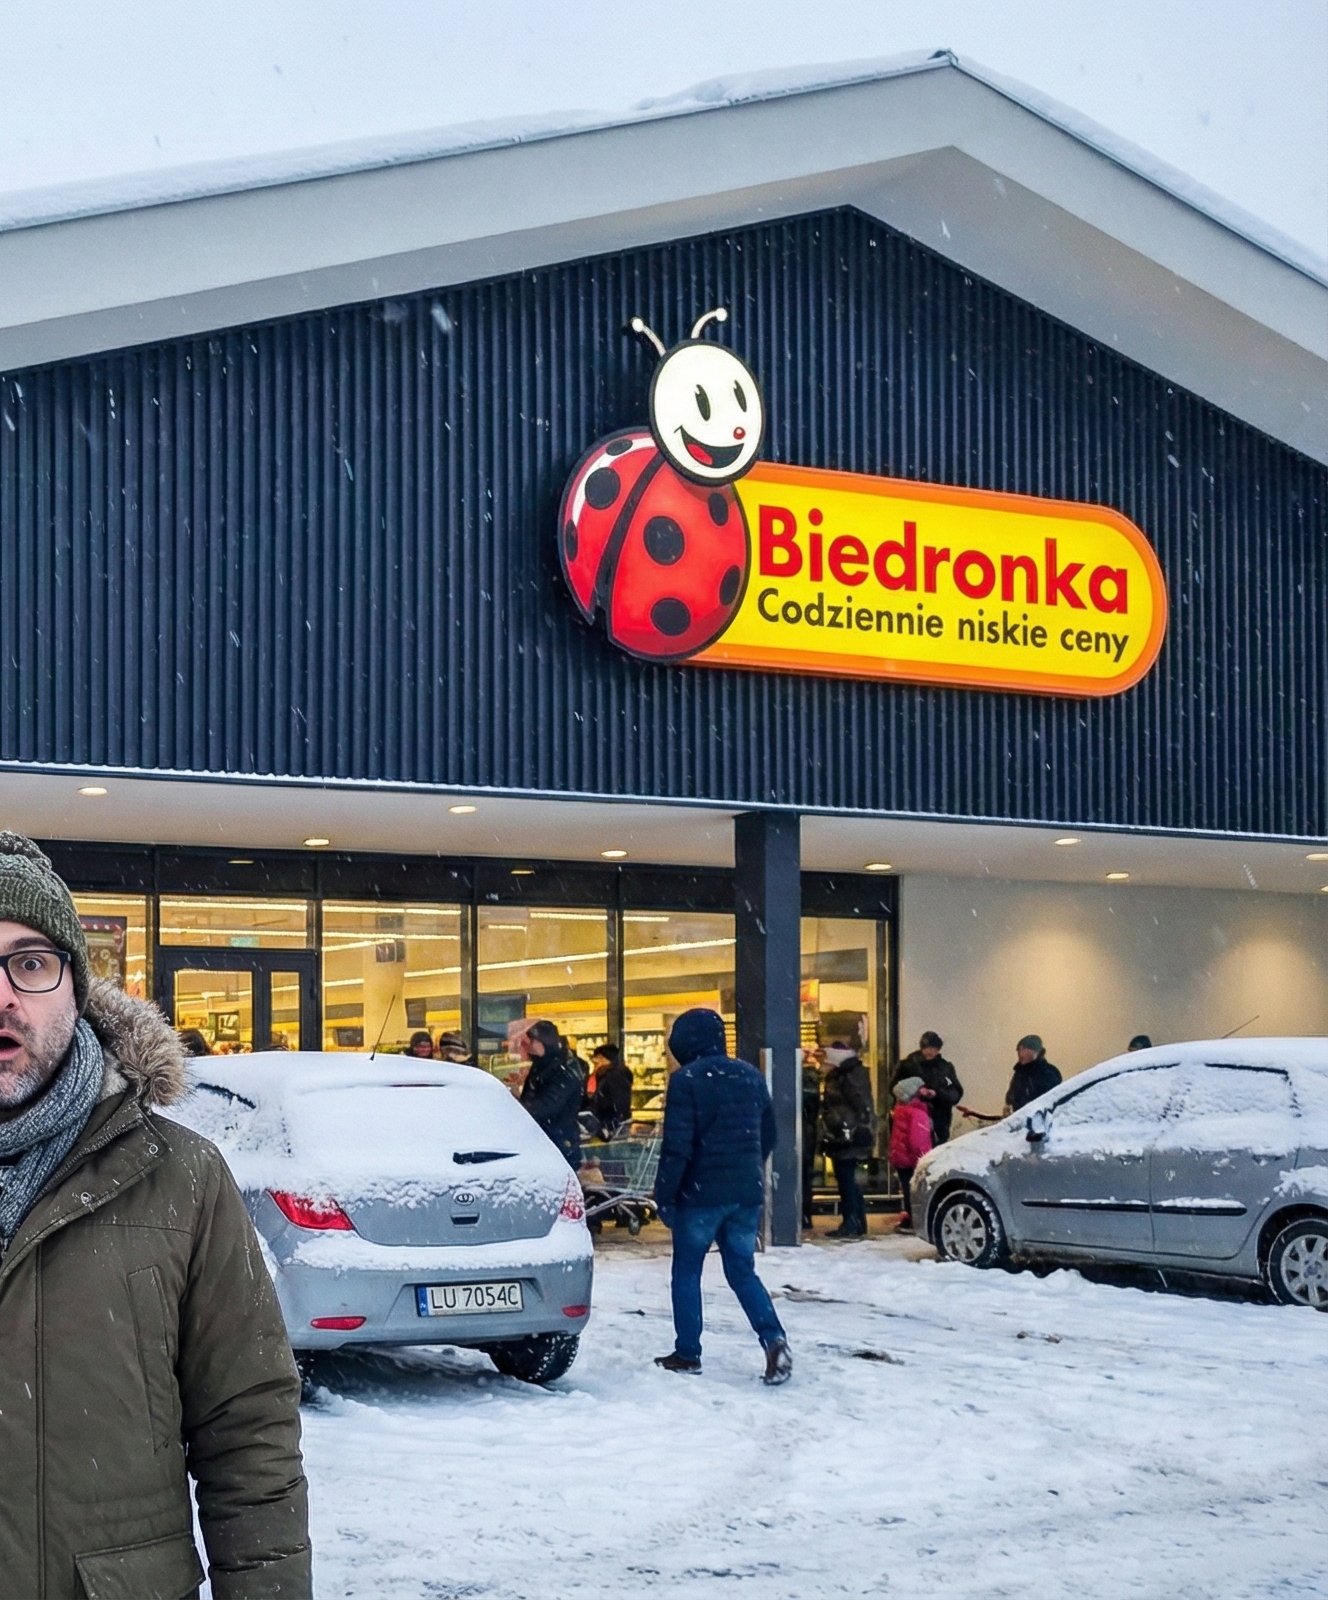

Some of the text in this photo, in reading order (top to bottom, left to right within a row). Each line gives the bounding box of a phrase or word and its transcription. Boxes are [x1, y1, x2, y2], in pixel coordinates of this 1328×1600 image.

[758, 503, 1129, 615] Biedronka
[757, 587, 1130, 663] Codziennie niskie ceny
[430, 1285, 519, 1309] LU 7054C
